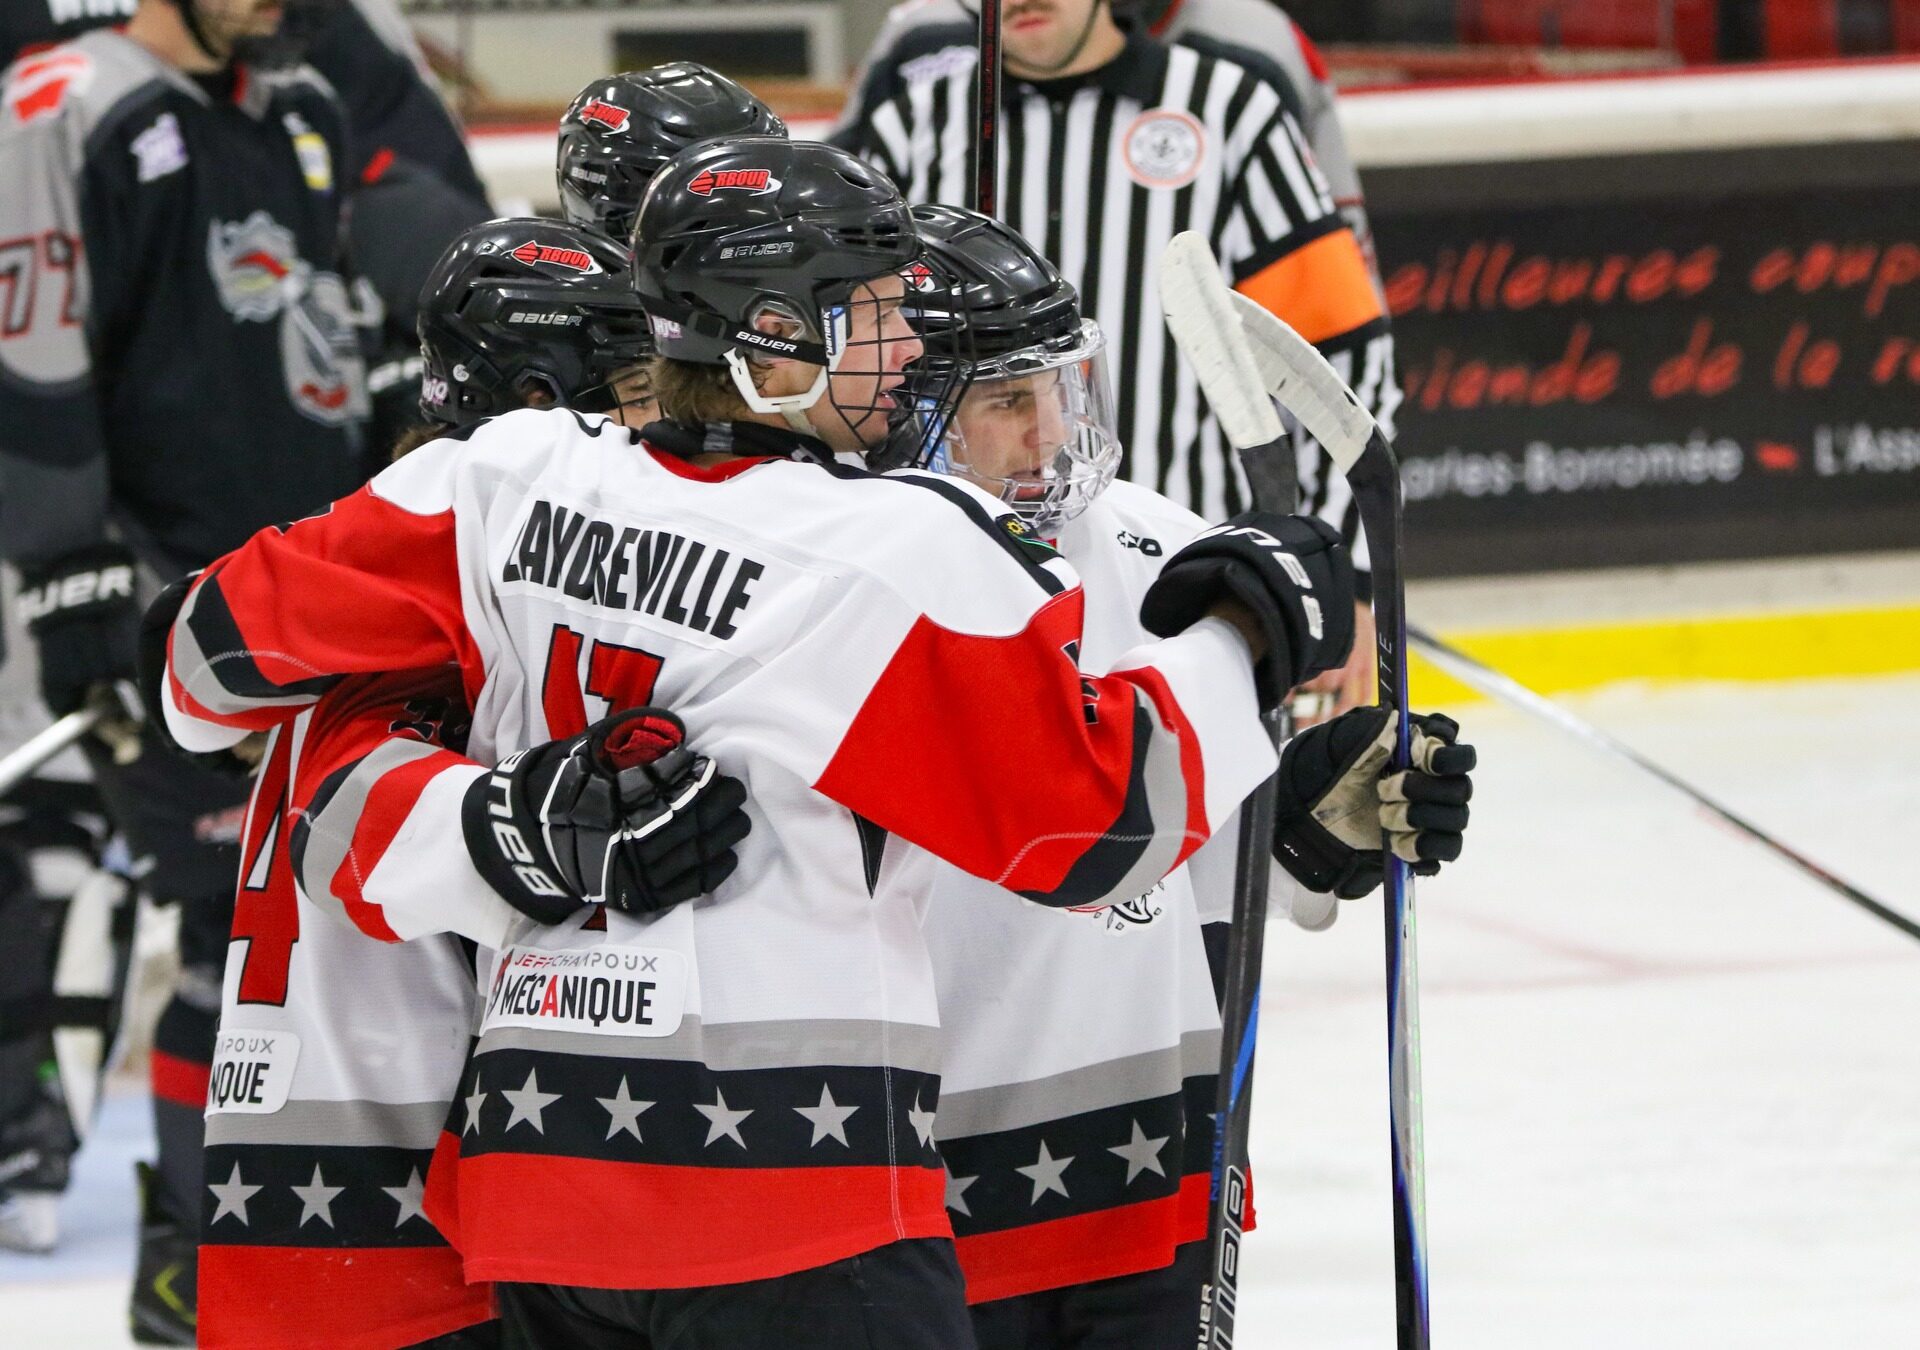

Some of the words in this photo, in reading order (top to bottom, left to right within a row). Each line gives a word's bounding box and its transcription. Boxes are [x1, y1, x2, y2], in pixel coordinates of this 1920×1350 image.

[508, 311, 583, 327] BAUER
[736, 330, 798, 354] BAUER
[1652, 317, 1741, 398] de
[499, 972, 657, 1028] MÉCANIQUE
